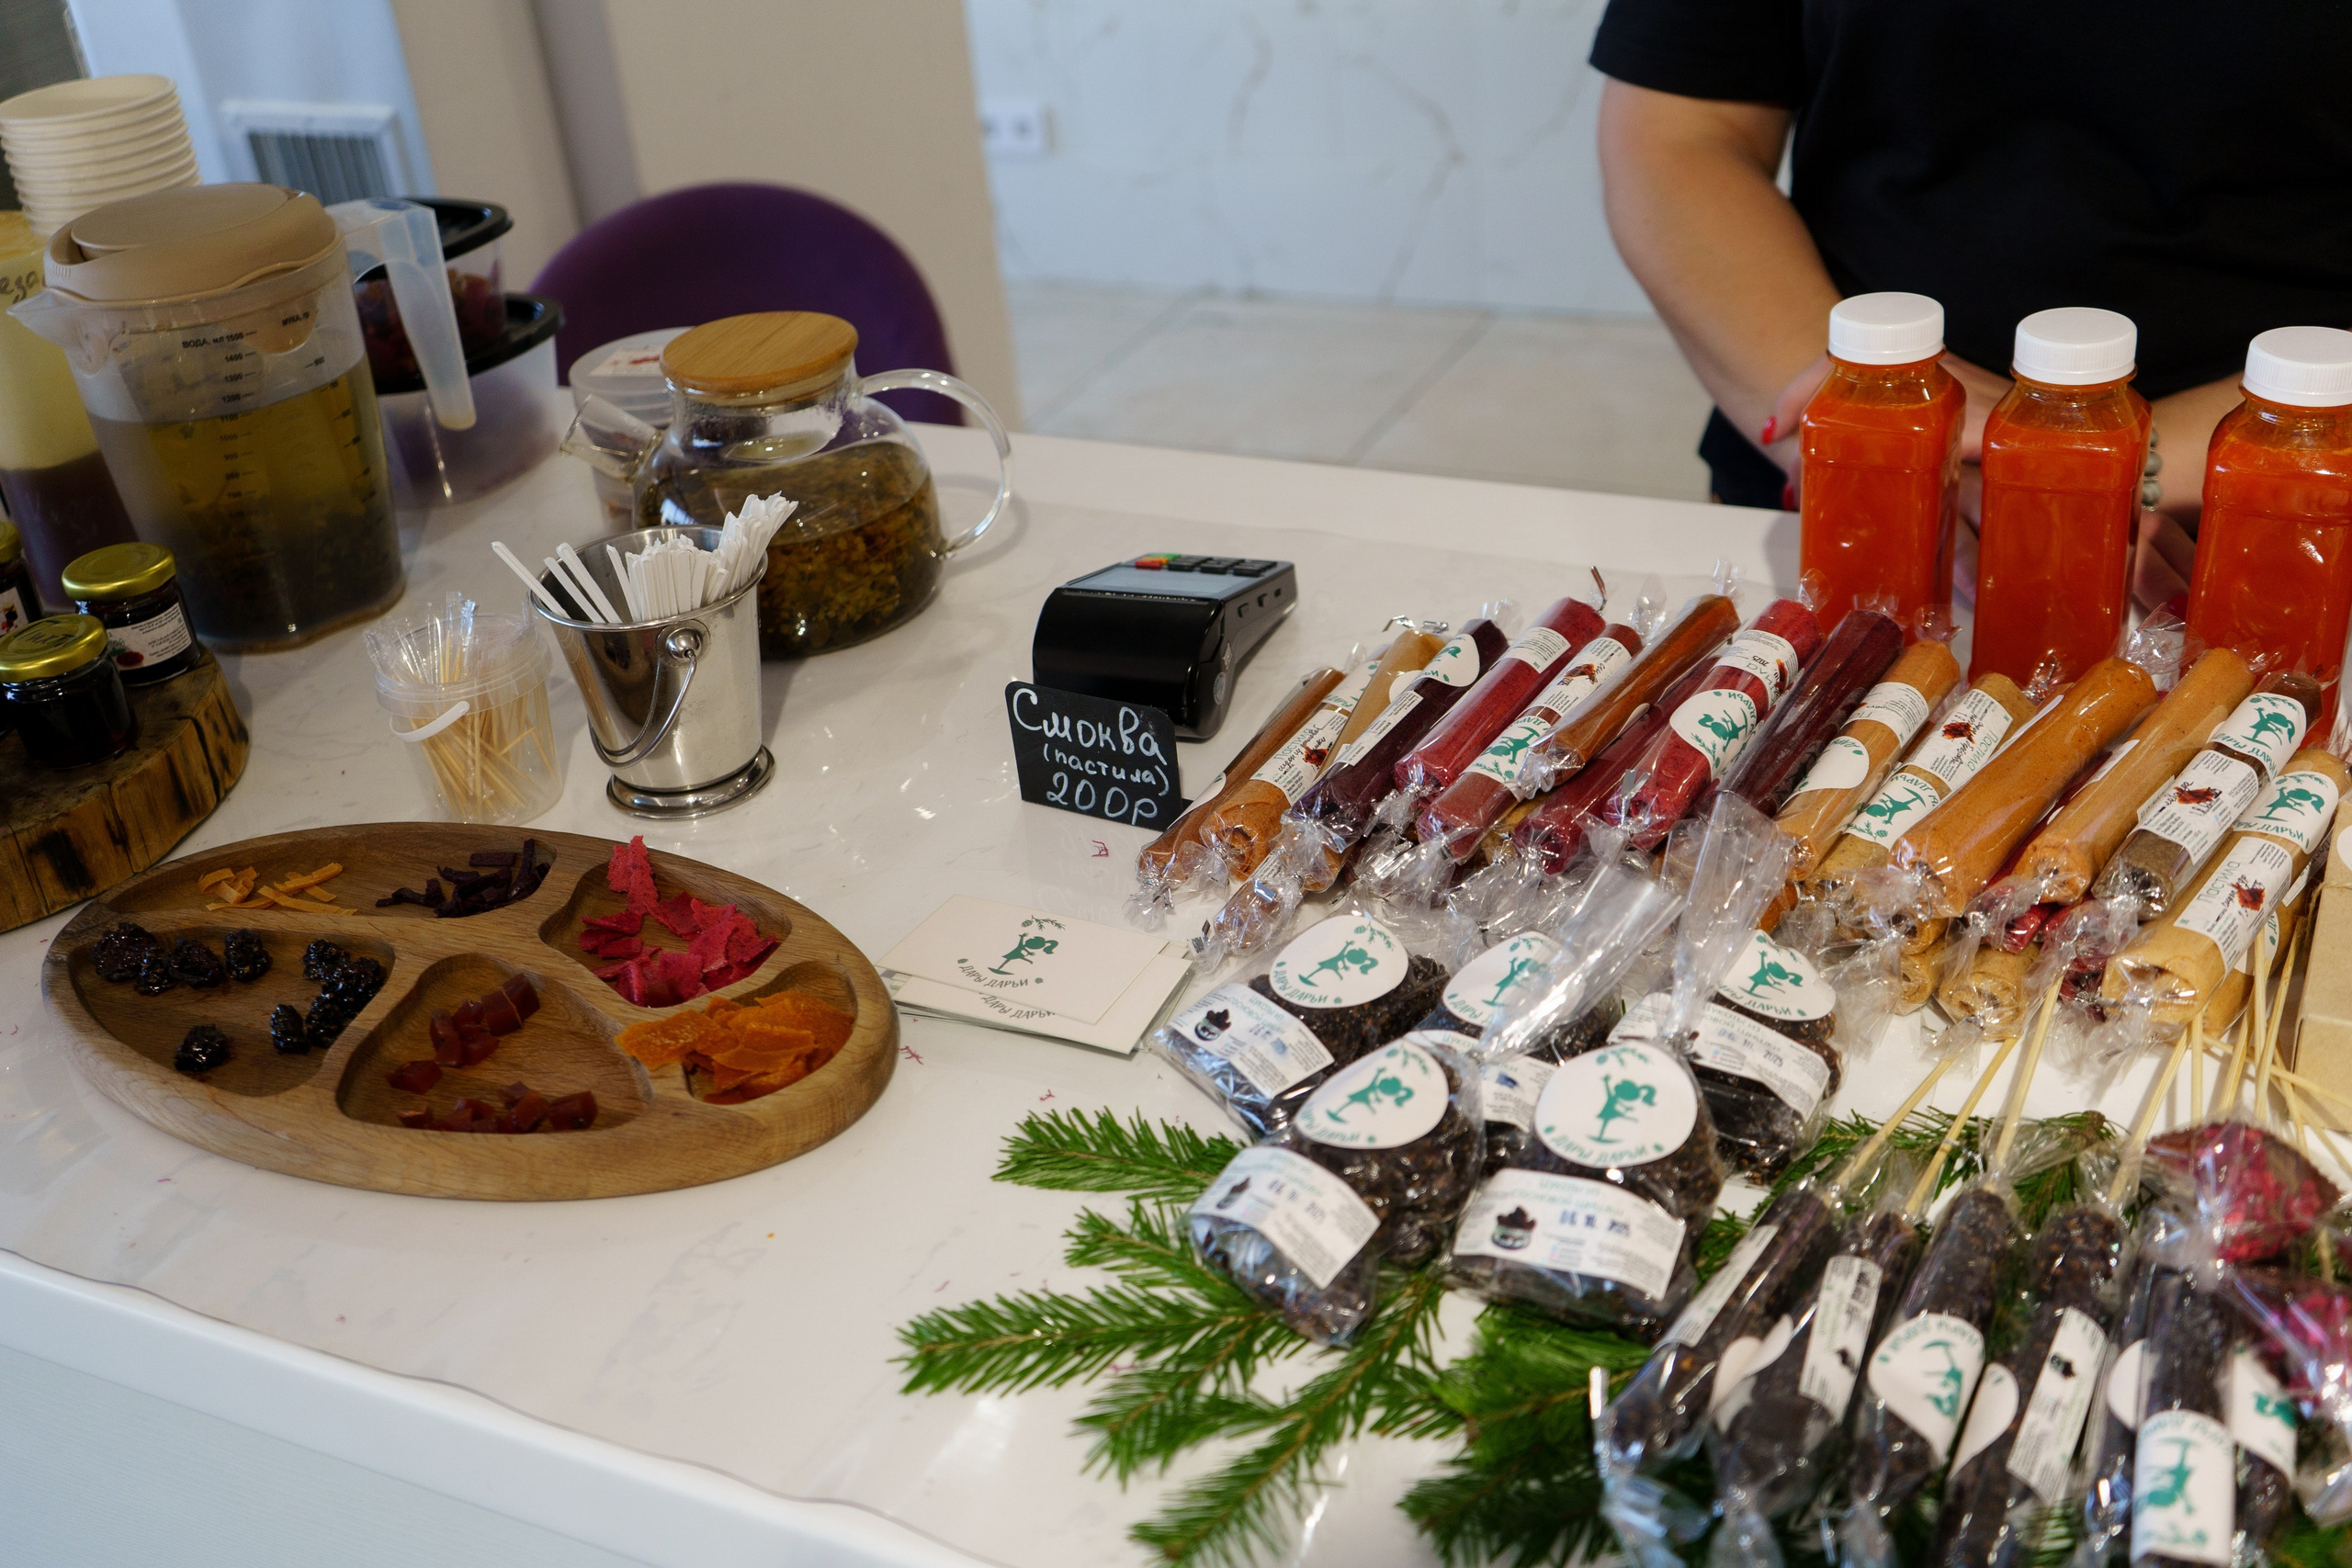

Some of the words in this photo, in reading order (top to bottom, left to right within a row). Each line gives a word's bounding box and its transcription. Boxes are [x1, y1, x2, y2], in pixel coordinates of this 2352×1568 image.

[1728, 692, 1757, 719] ДАРЬИ
[1013, 688, 1167, 765] Смоква
[1273, 728, 1314, 761] Пастила
[1968, 729, 1998, 773] Пастила
[1044, 743, 1170, 796] (пастила)
[2256, 824, 2303, 842] ДАРЬИ
[2197, 861, 2241, 904] Пастила
[958, 965, 988, 982] ДАРЫ
[983, 978, 1028, 988] ДАРЬИ
[1273, 970, 1291, 993] ДАРЫ
[1287, 987, 1328, 1004] ДАРЬИ
[980, 996, 1012, 1014] ДАРЫ
[1744, 998, 1792, 1016] ДАРЬИ
[1761, 1049, 1785, 1066] 2025
